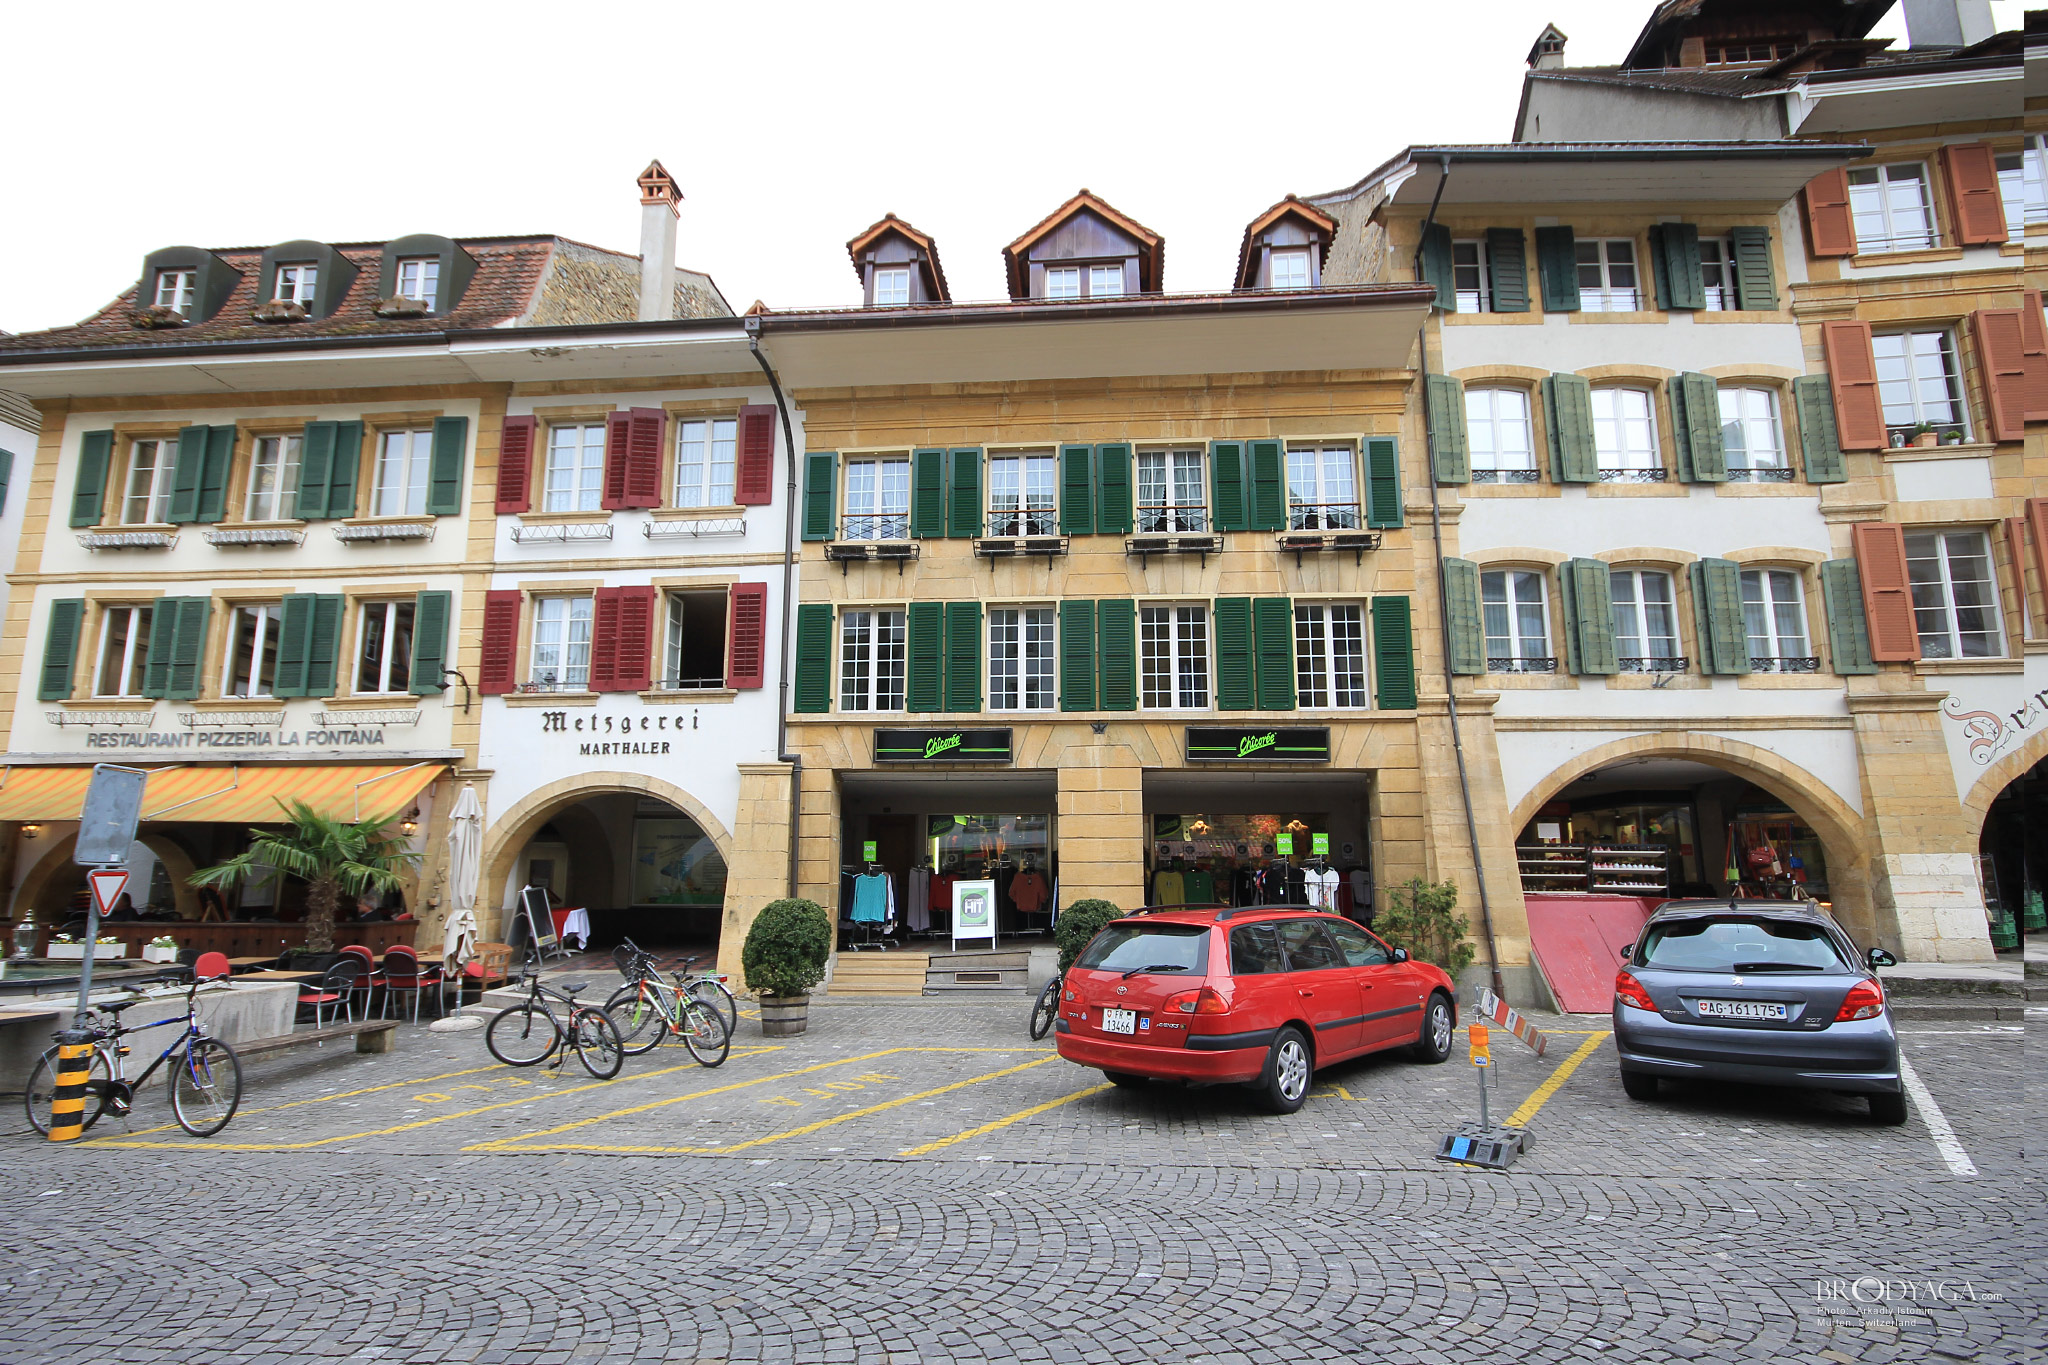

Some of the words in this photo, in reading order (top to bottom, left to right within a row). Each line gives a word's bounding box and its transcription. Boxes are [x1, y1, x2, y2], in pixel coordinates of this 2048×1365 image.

[542, 708, 698, 733] Metzgerei
[86, 732, 194, 748] RESTAURANT
[197, 731, 272, 747] PIZZERIA
[278, 731, 299, 746] LA
[305, 729, 384, 745] FONTANA
[580, 742, 670, 756] MARTHALER
[964, 901, 984, 914] HIT
[1115, 1010, 1123, 1020] FR
[1107, 1020, 1131, 1033] 13466
